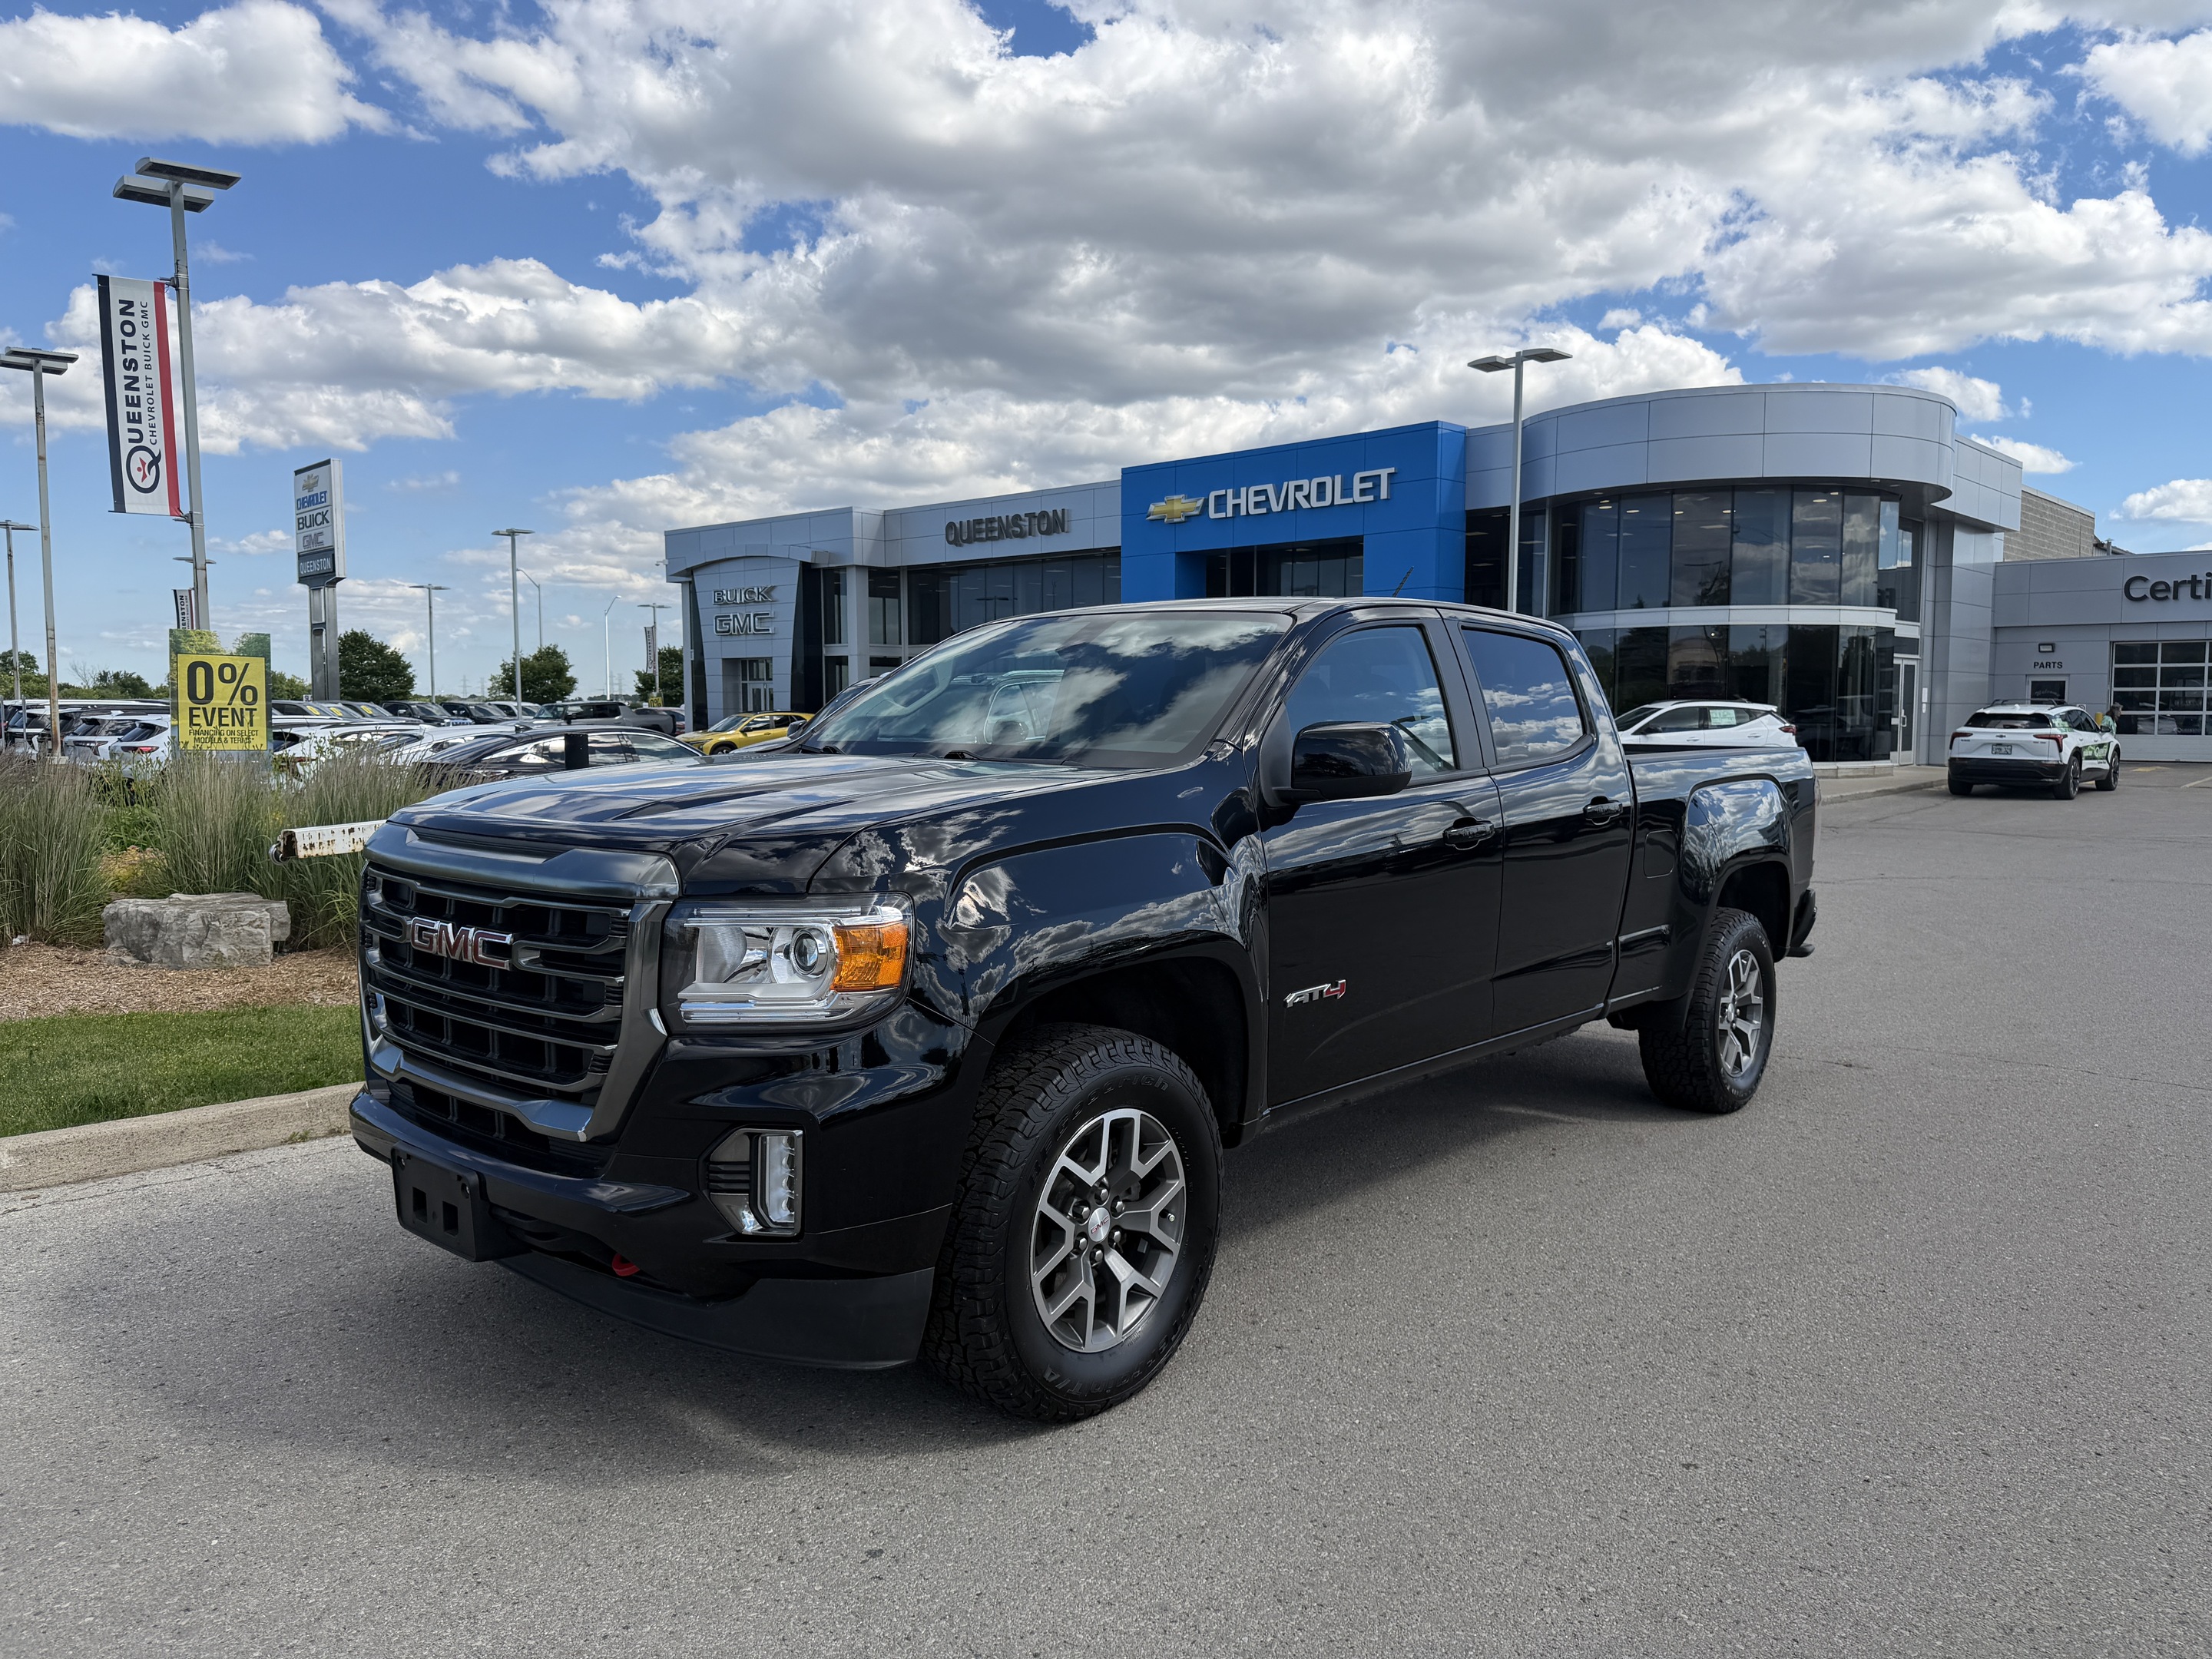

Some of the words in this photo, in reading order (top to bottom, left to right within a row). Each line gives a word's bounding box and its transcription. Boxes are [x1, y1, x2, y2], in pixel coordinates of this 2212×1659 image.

[141, 300, 149, 329] GMC
[143, 333, 152, 370] BUICK
[118, 298, 162, 494] QUEENSTON
[145, 375, 157, 445] CHEVROLET
[296, 490, 328, 511] CHEVROLET
[1208, 467, 1396, 519] CHEVROLET
[297, 510, 329, 531] BUICK
[945, 508, 1070, 547] QUEENSTON
[302, 531, 325, 549] GMC
[300, 558, 332, 574] QUEENSTON
[713, 585, 775, 605] BUICK
[2124, 572, 2212, 602] Certi
[714, 611, 775, 636] GMC
[187, 661, 258, 706] 0%
[188, 707, 257, 727] EVENT
[411, 916, 514, 972] GMC
[1283, 979, 1346, 1008] AT4
[1091, 1215, 1110, 1233] GMC
